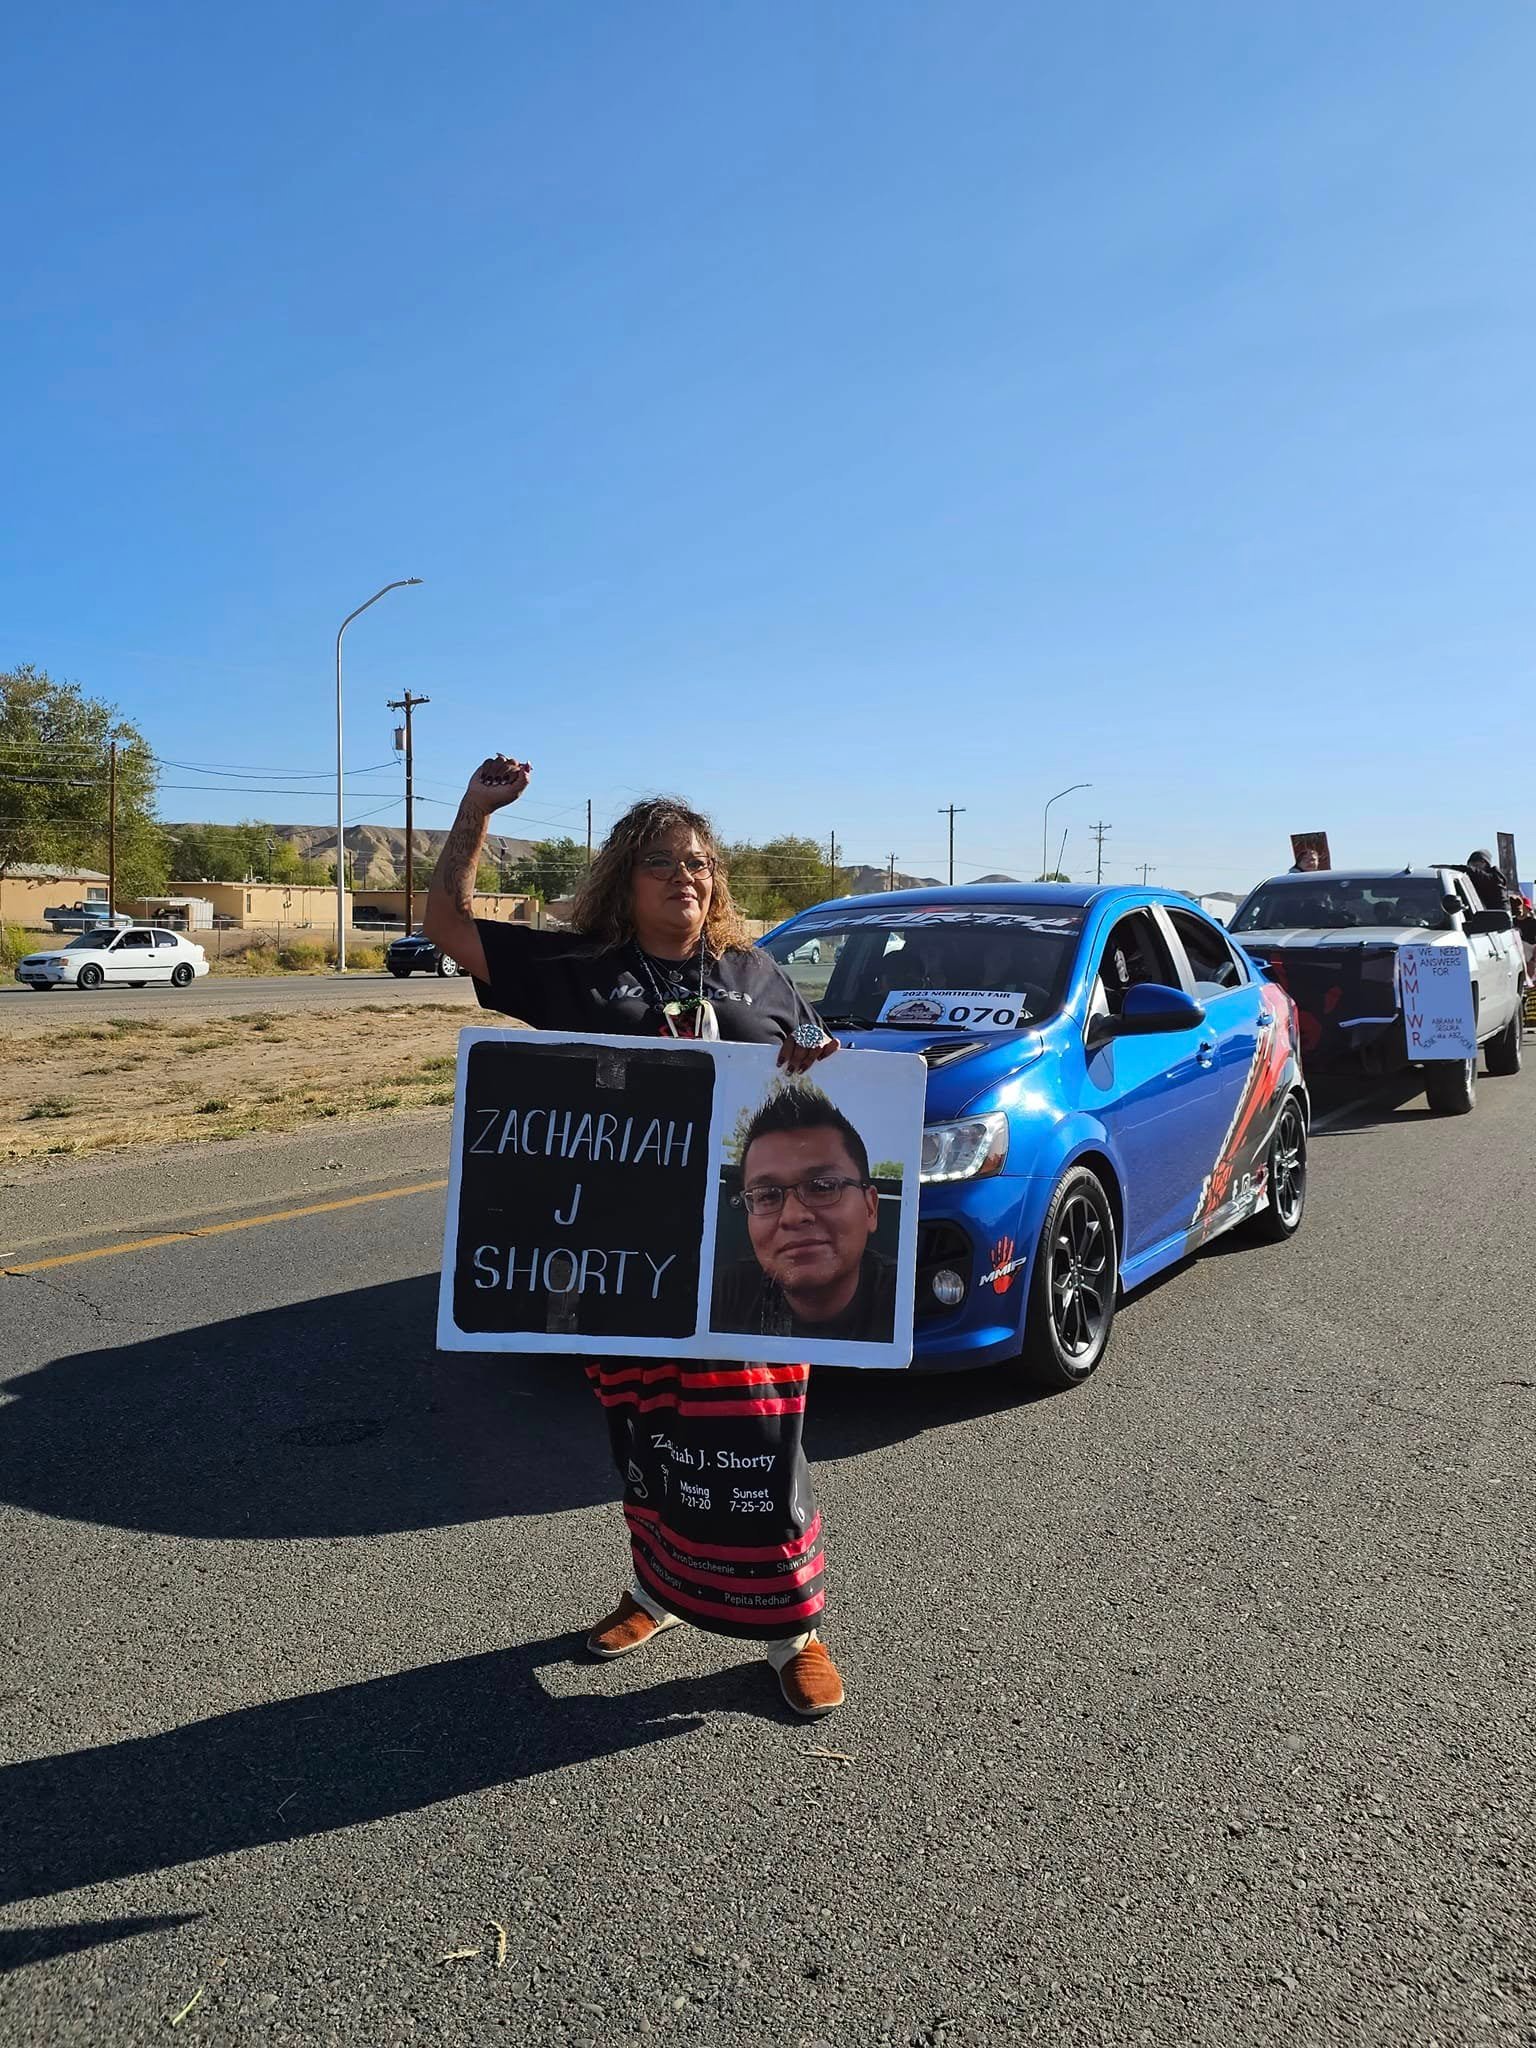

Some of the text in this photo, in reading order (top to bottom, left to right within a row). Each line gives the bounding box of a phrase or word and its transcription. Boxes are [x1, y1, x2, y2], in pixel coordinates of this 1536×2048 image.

[1420, 947, 1462, 956] WE NEED
[1420, 957, 1462, 967] ANSWERS
[1432, 967, 1449, 976] FOR
[948, 1006, 1016, 1026] 070
[469, 1108, 693, 1168] ZACHARIAH
[553, 1183, 582, 1226] J
[473, 1244, 677, 1300] SHORTY
[978, 1255, 1027, 1287] MMIP
[697, 1448, 711, 1471] J.
[716, 1450, 777, 1473] Shorty
[680, 1492, 712, 1511] 7-21-20
[732, 1487, 770, 1499] Sunset
[729, 1500, 775, 1513] 7-25-20
[724, 1592, 792, 1606] Pepita Redhair
